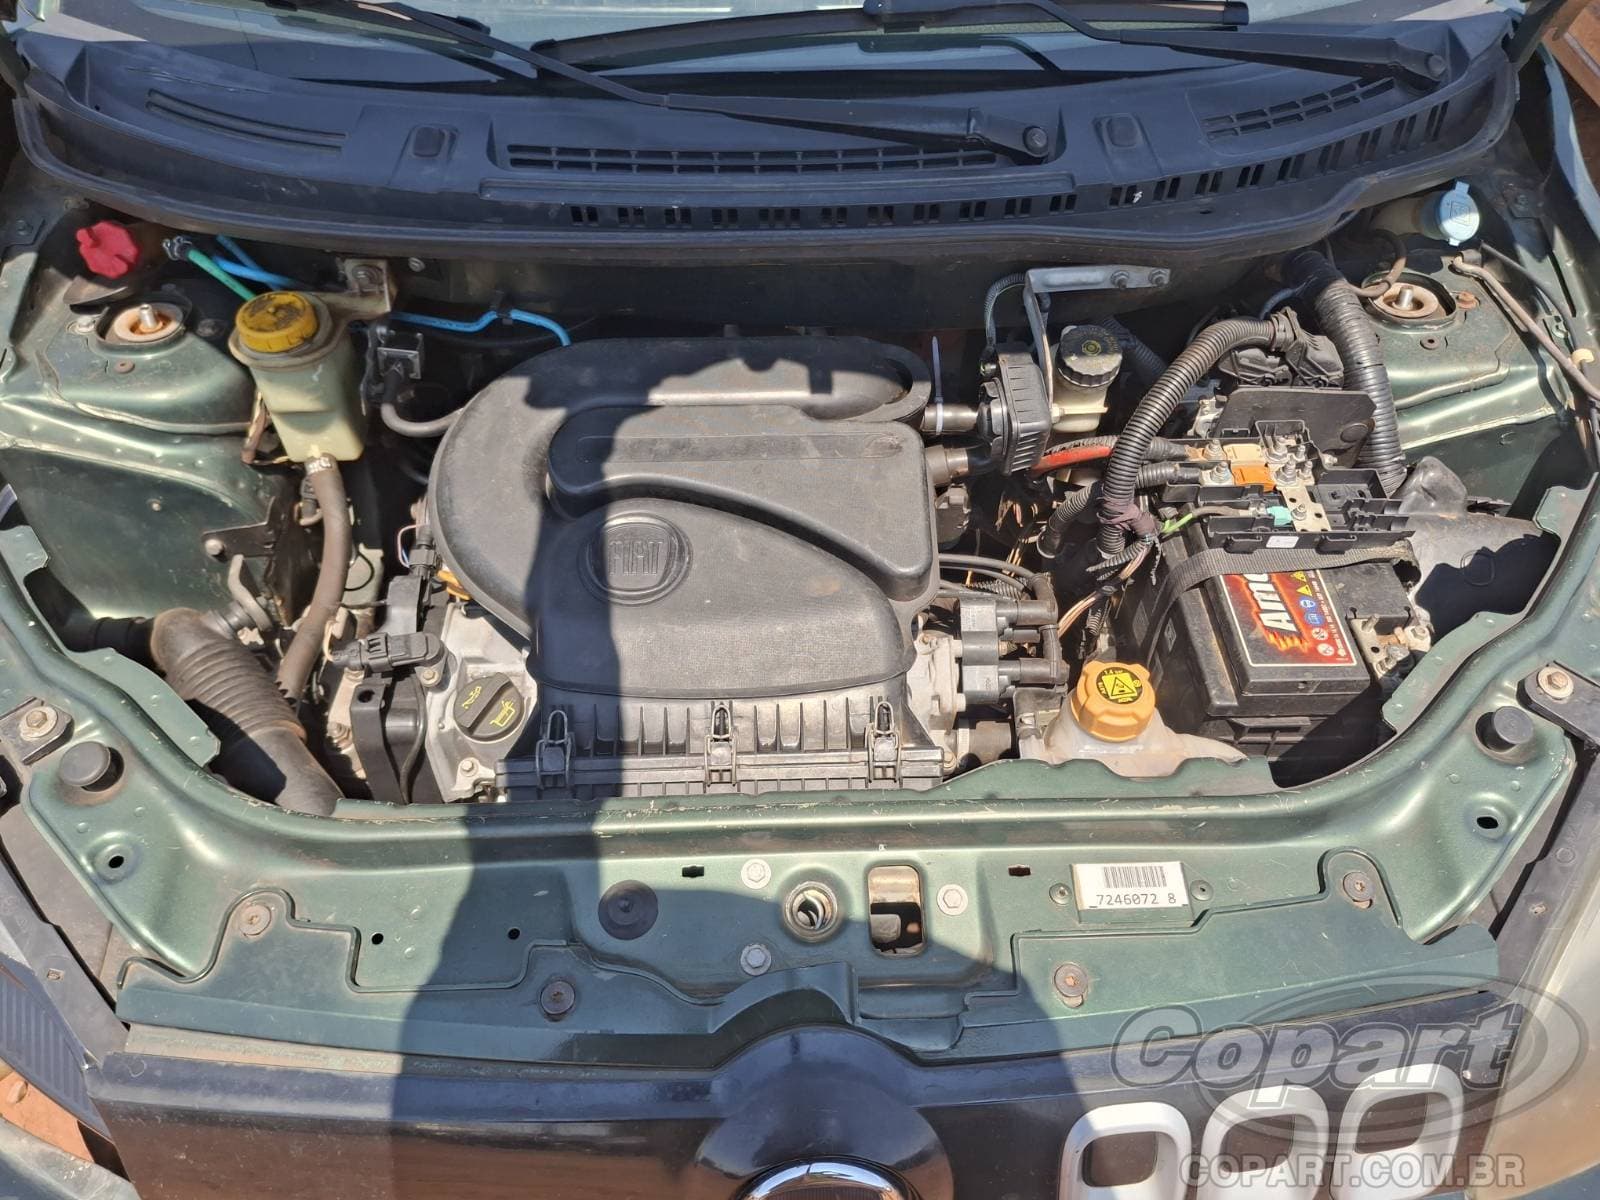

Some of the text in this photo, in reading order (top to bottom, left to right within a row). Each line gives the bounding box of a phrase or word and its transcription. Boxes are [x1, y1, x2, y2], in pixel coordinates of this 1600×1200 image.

[608, 540, 663, 576] FIAT
[1096, 892, 1177, 906] 7246072 8
